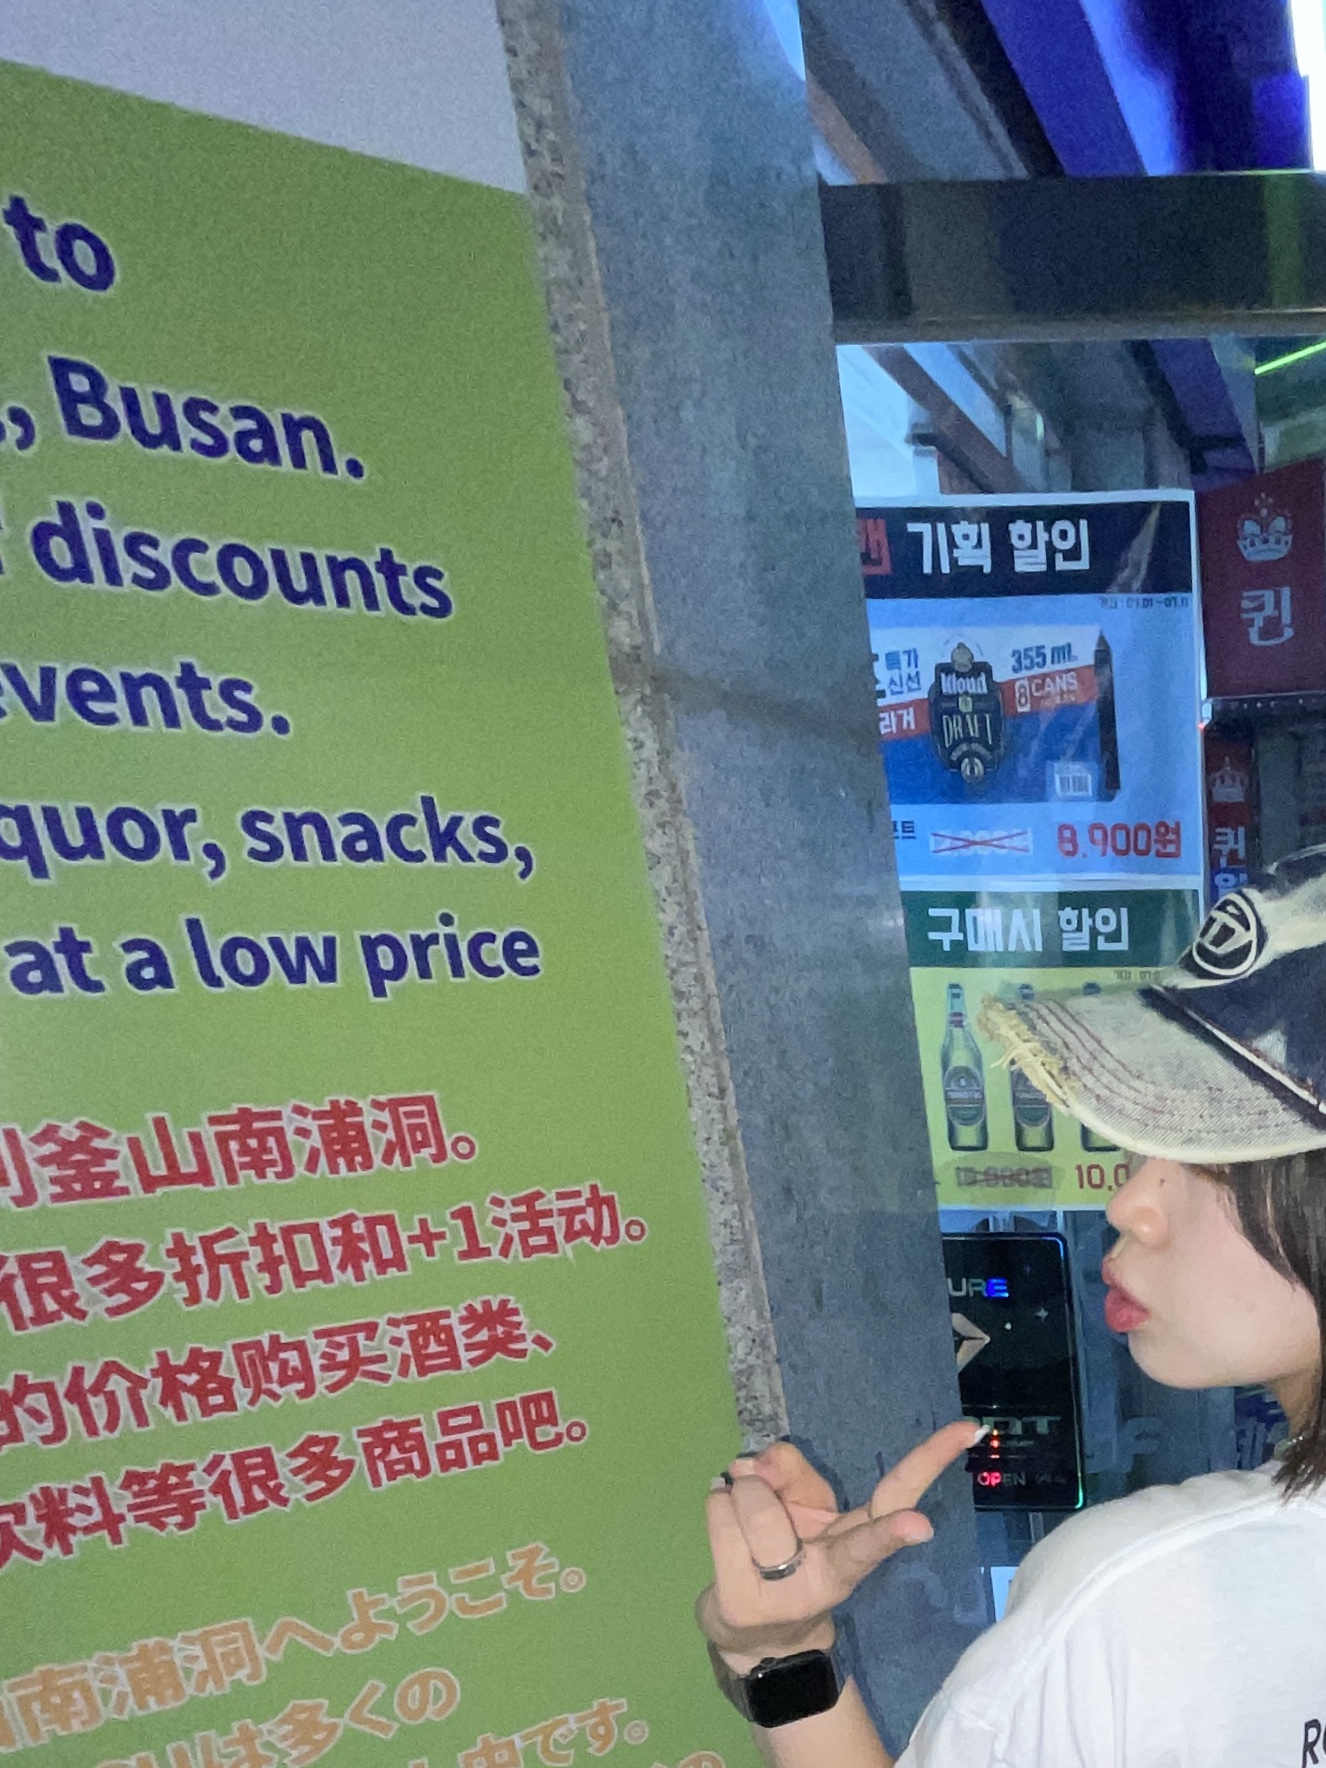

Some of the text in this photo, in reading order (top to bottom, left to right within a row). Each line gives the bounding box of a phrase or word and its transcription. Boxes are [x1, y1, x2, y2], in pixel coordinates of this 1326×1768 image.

[4, 196, 116, 291] to
[47, 354, 366, 479] Busan.
[29, 500, 454, 619] discounts
[907, 520, 992, 574] 기획
[1008, 518, 1091, 573] 할인
[1241, 586, 1294, 646] 퀸
[1011, 645, 1047, 674] 355
[1031, 672, 1078, 697] CANS
[0, 662, 291, 736] vents.
[243, 796, 535, 880] snacks,
[6, 914, 543, 999] at a low price
[927, 906, 1130, 954] 구매시 할인
[977, 1472, 1026, 1487] OPEN
[0, 1543, 588, 1751] 南浦洞へようこそ。
